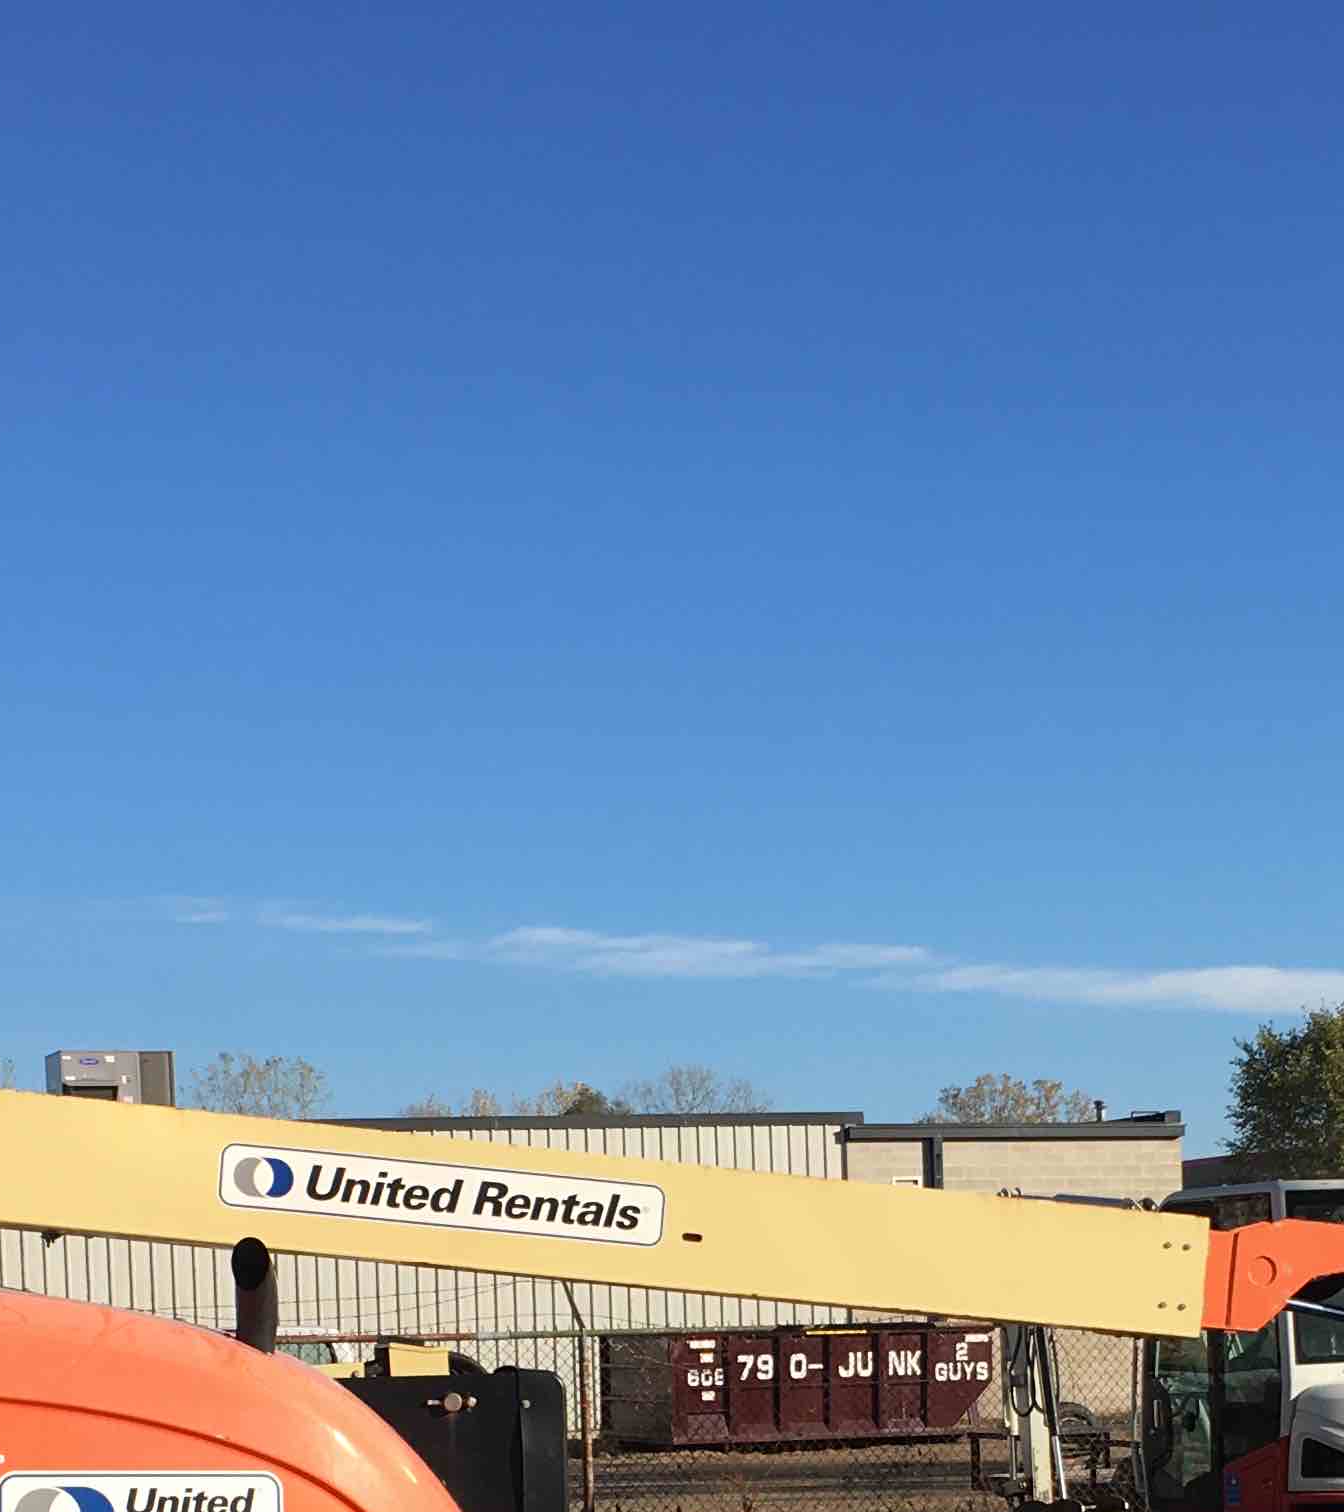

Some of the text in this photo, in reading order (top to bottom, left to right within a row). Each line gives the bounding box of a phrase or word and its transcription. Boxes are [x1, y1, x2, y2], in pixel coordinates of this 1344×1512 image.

[306, 1164, 643, 1231] United Rentals
[955, 1343, 969, 1361] 2
[934, 1361, 990, 1382] GUYS
